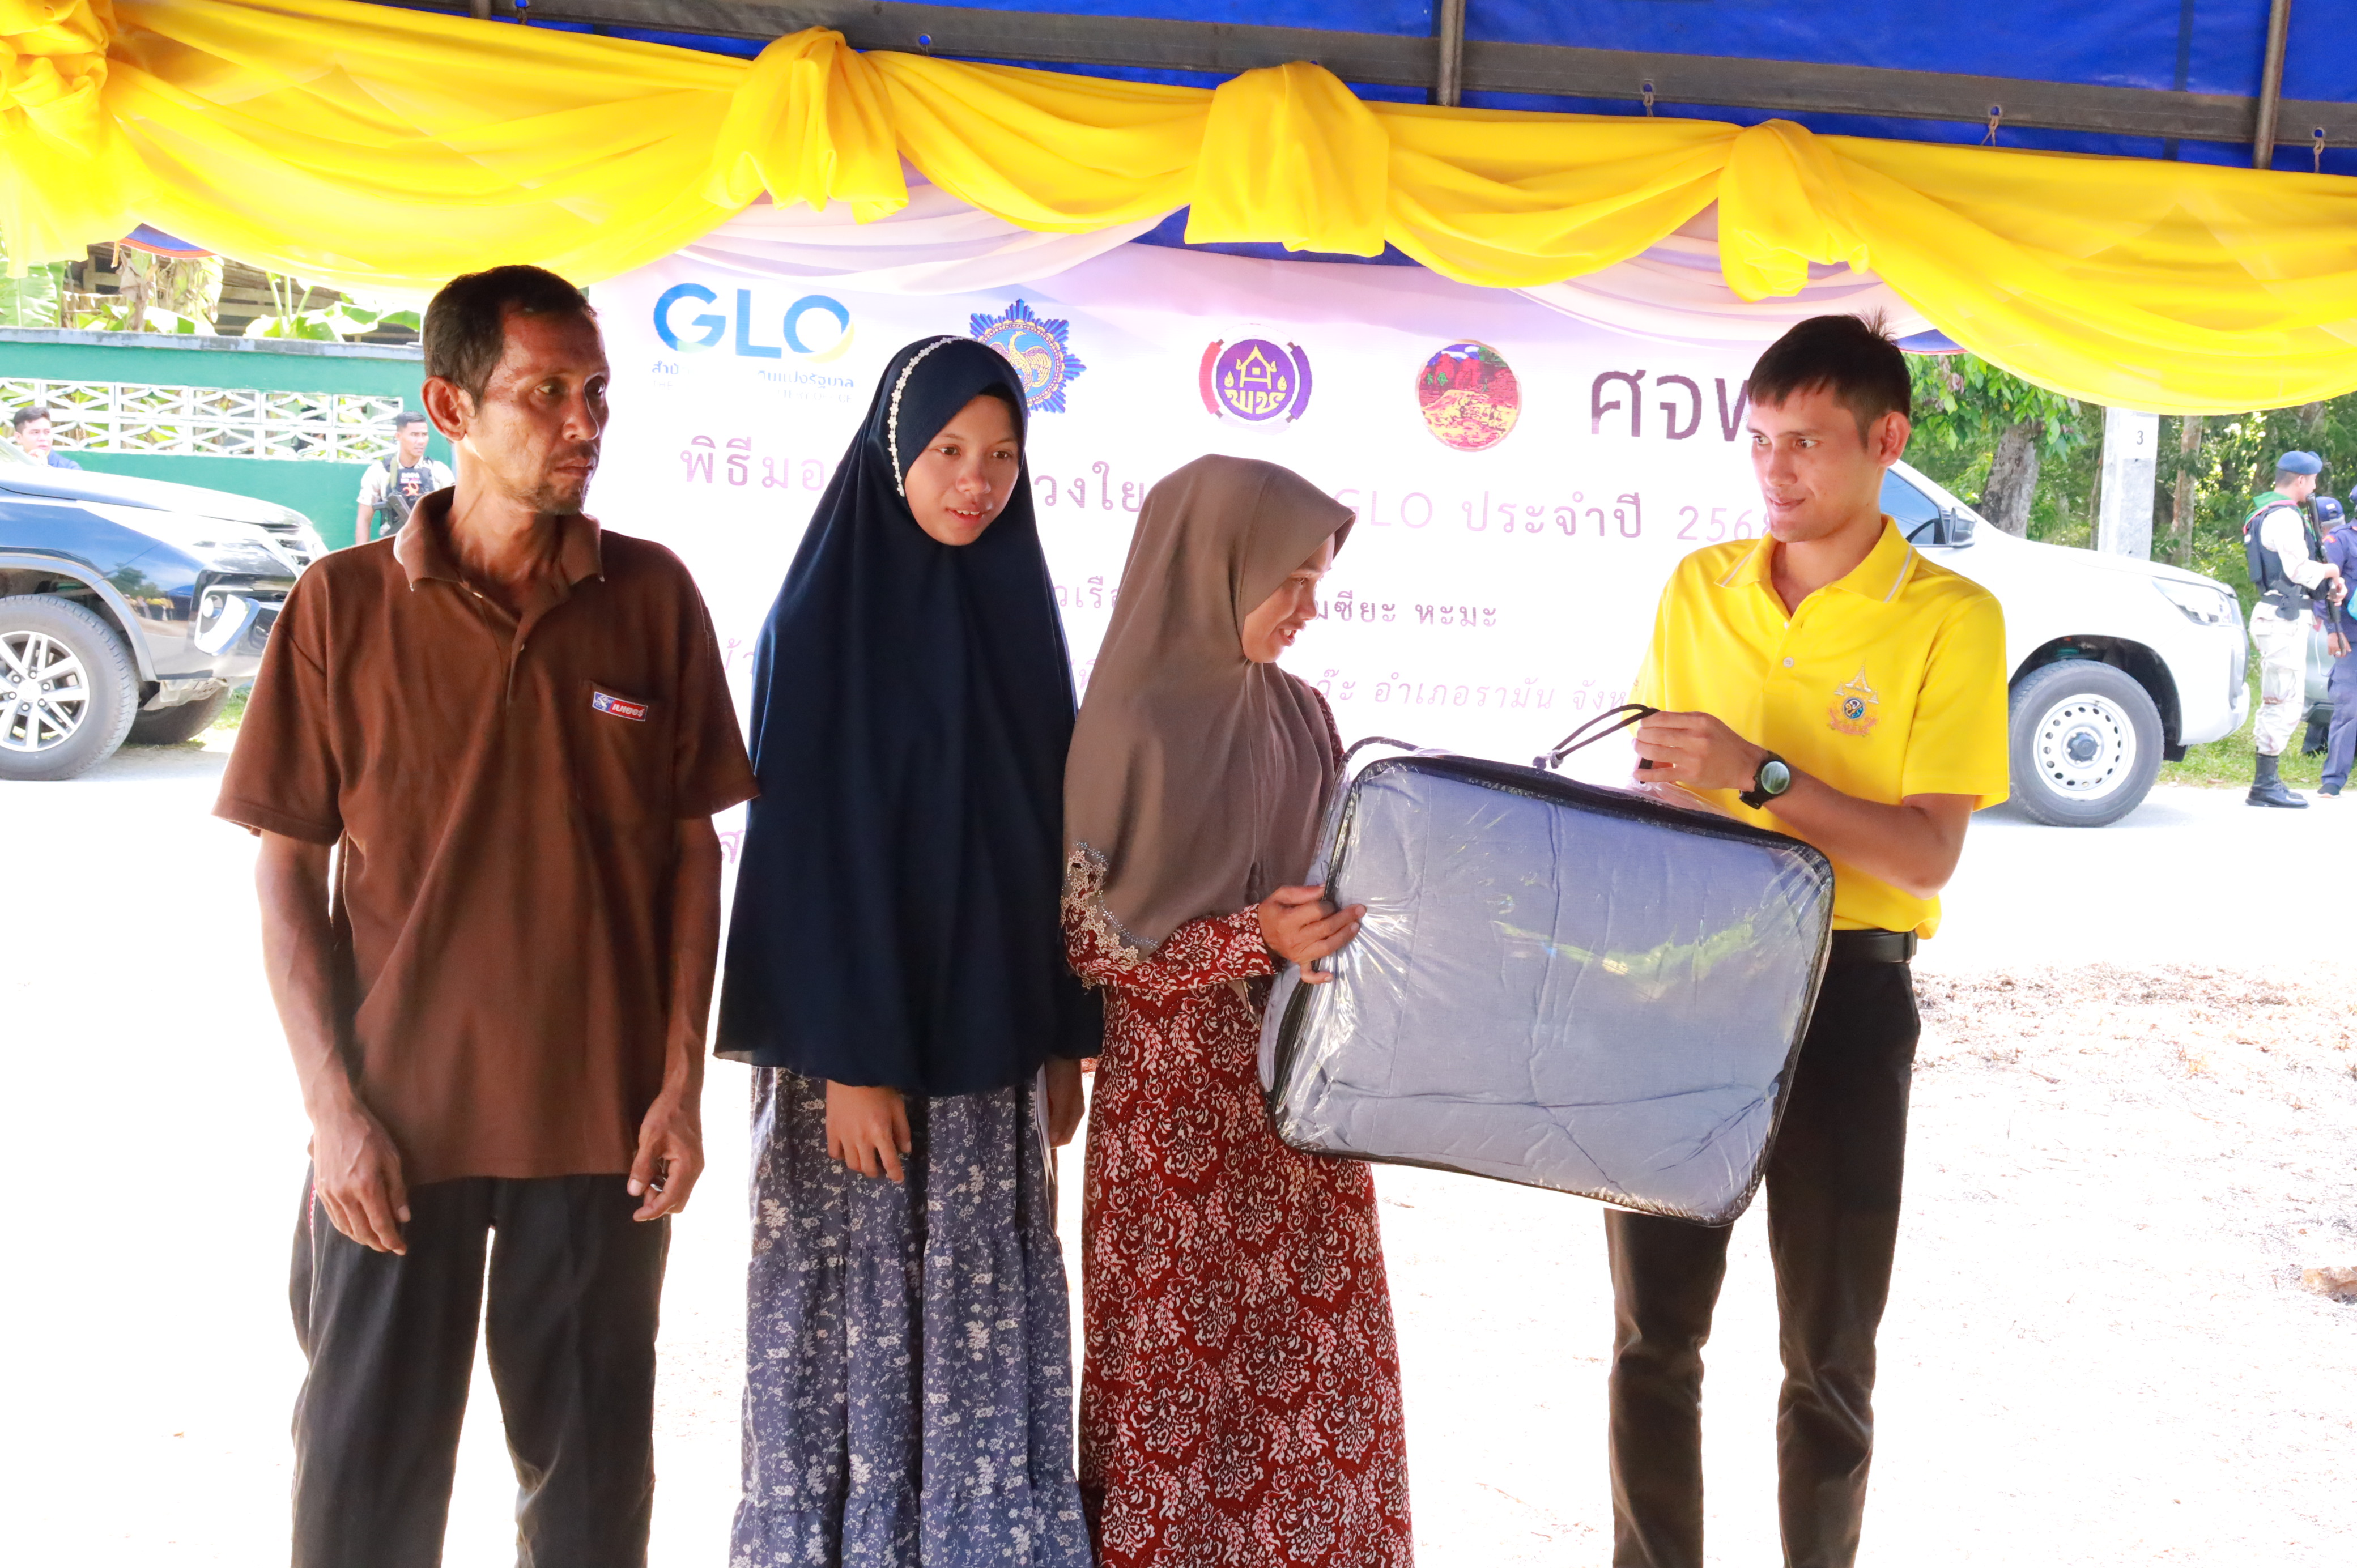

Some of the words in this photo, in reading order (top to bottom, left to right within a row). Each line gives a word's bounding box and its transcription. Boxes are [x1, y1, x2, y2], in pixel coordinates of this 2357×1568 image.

[653, 282, 855, 364] GLO
[2137, 430, 2144, 445] 3
[680, 435, 839, 491] พิธีมอ
[1461, 491, 1641, 539] ประจำปี
[1415, 604, 1497, 627] หะมะ
[1375, 671, 1556, 710] อำเภอรามัน
[1573, 679, 1627, 710] จังห
